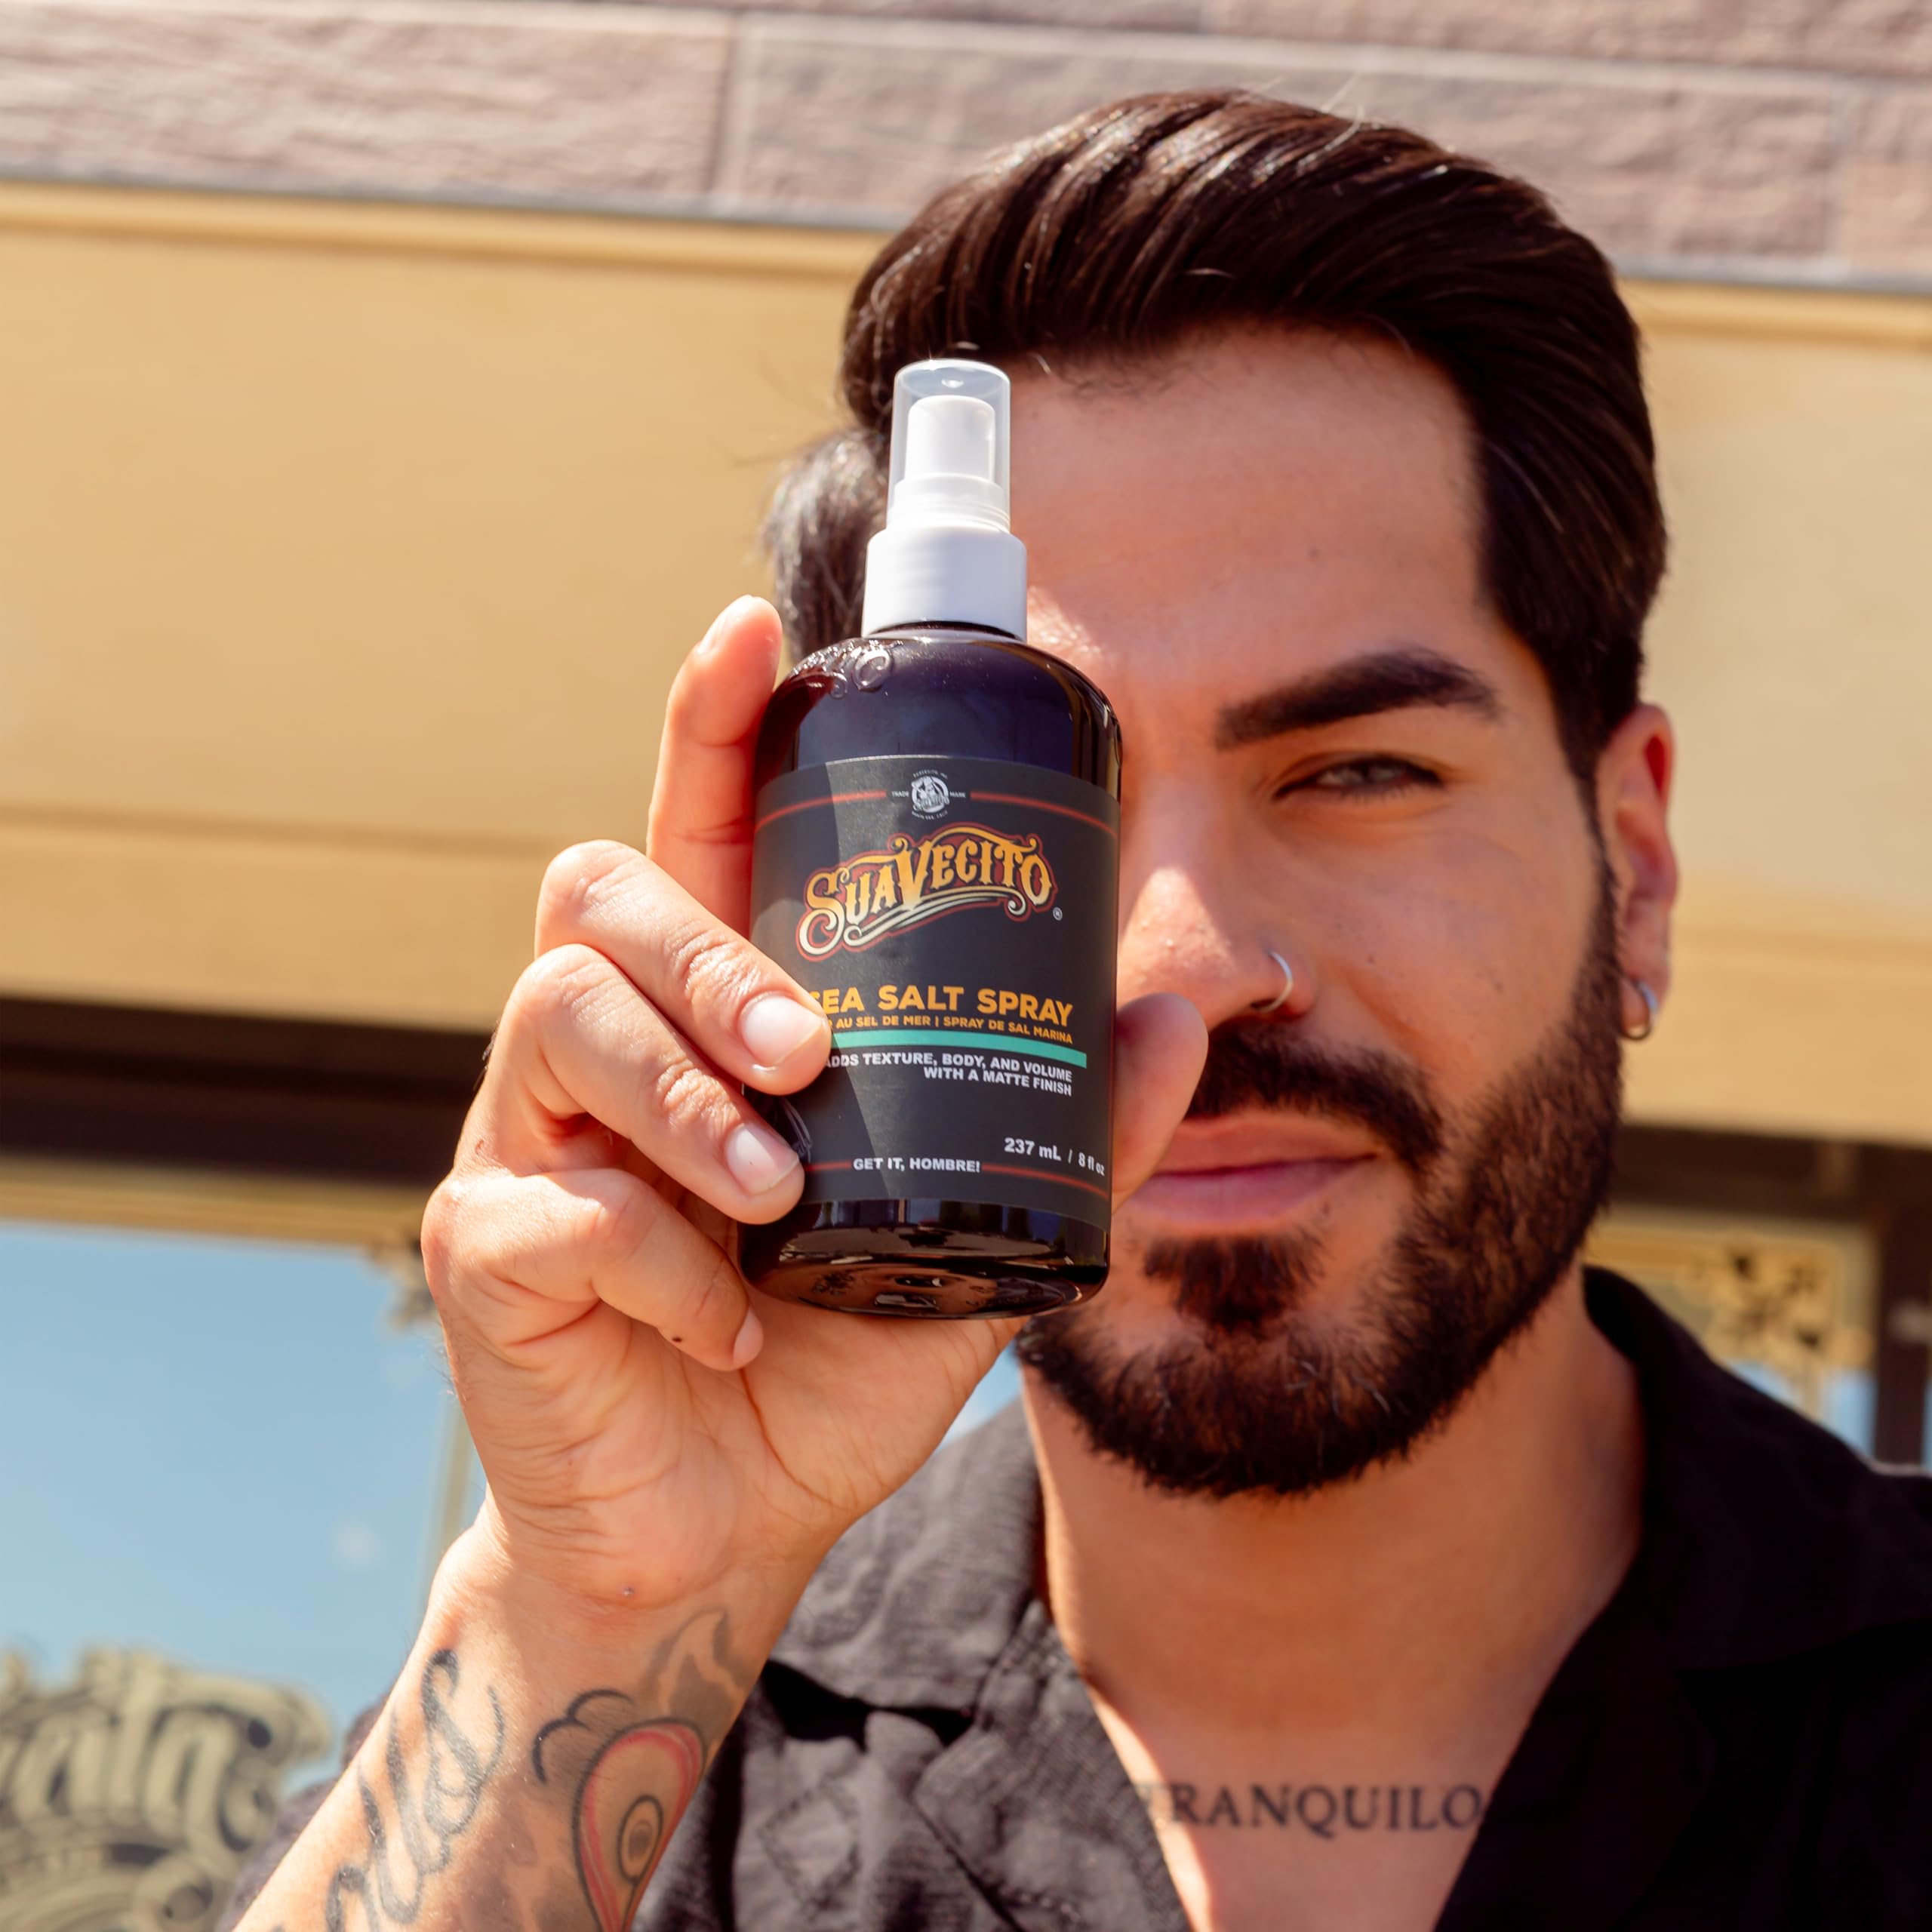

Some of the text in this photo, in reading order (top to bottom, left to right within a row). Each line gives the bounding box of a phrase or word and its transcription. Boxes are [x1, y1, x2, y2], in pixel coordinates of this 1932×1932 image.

[798, 824, 1056, 959] SUAVECITO
[809, 984, 1073, 1027] EA SALT SPRAY
[836, 1017, 853, 1029] AU
[856, 1016, 878, 1027] SEL
[882, 1015, 899, 1026] DE
[903, 1015, 931, 1026] MER
[943, 1017, 984, 1029] SPRAY
[988, 1020, 1004, 1032] DE
[1008, 1023, 1031, 1035] SAL
[1033, 1026, 1073, 1044] MARINA
[862, 1052, 938, 1066] TEXTURE,
[942, 1054, 986, 1069] BODY,
[990, 1057, 1020, 1072] AND
[1023, 1060, 1072, 1082] VOLUME
[923, 1067, 1072, 1097] WITH A MATTE FINISH
[853, 1158, 980, 1173] GET IT, HOMBRE!
[1004, 1137, 1035, 1155] 237
[1039, 1145, 1062, 1161] mL
[1078, 1152, 1086, 1168] 8
[1096, 1162, 1105, 1177] oz
